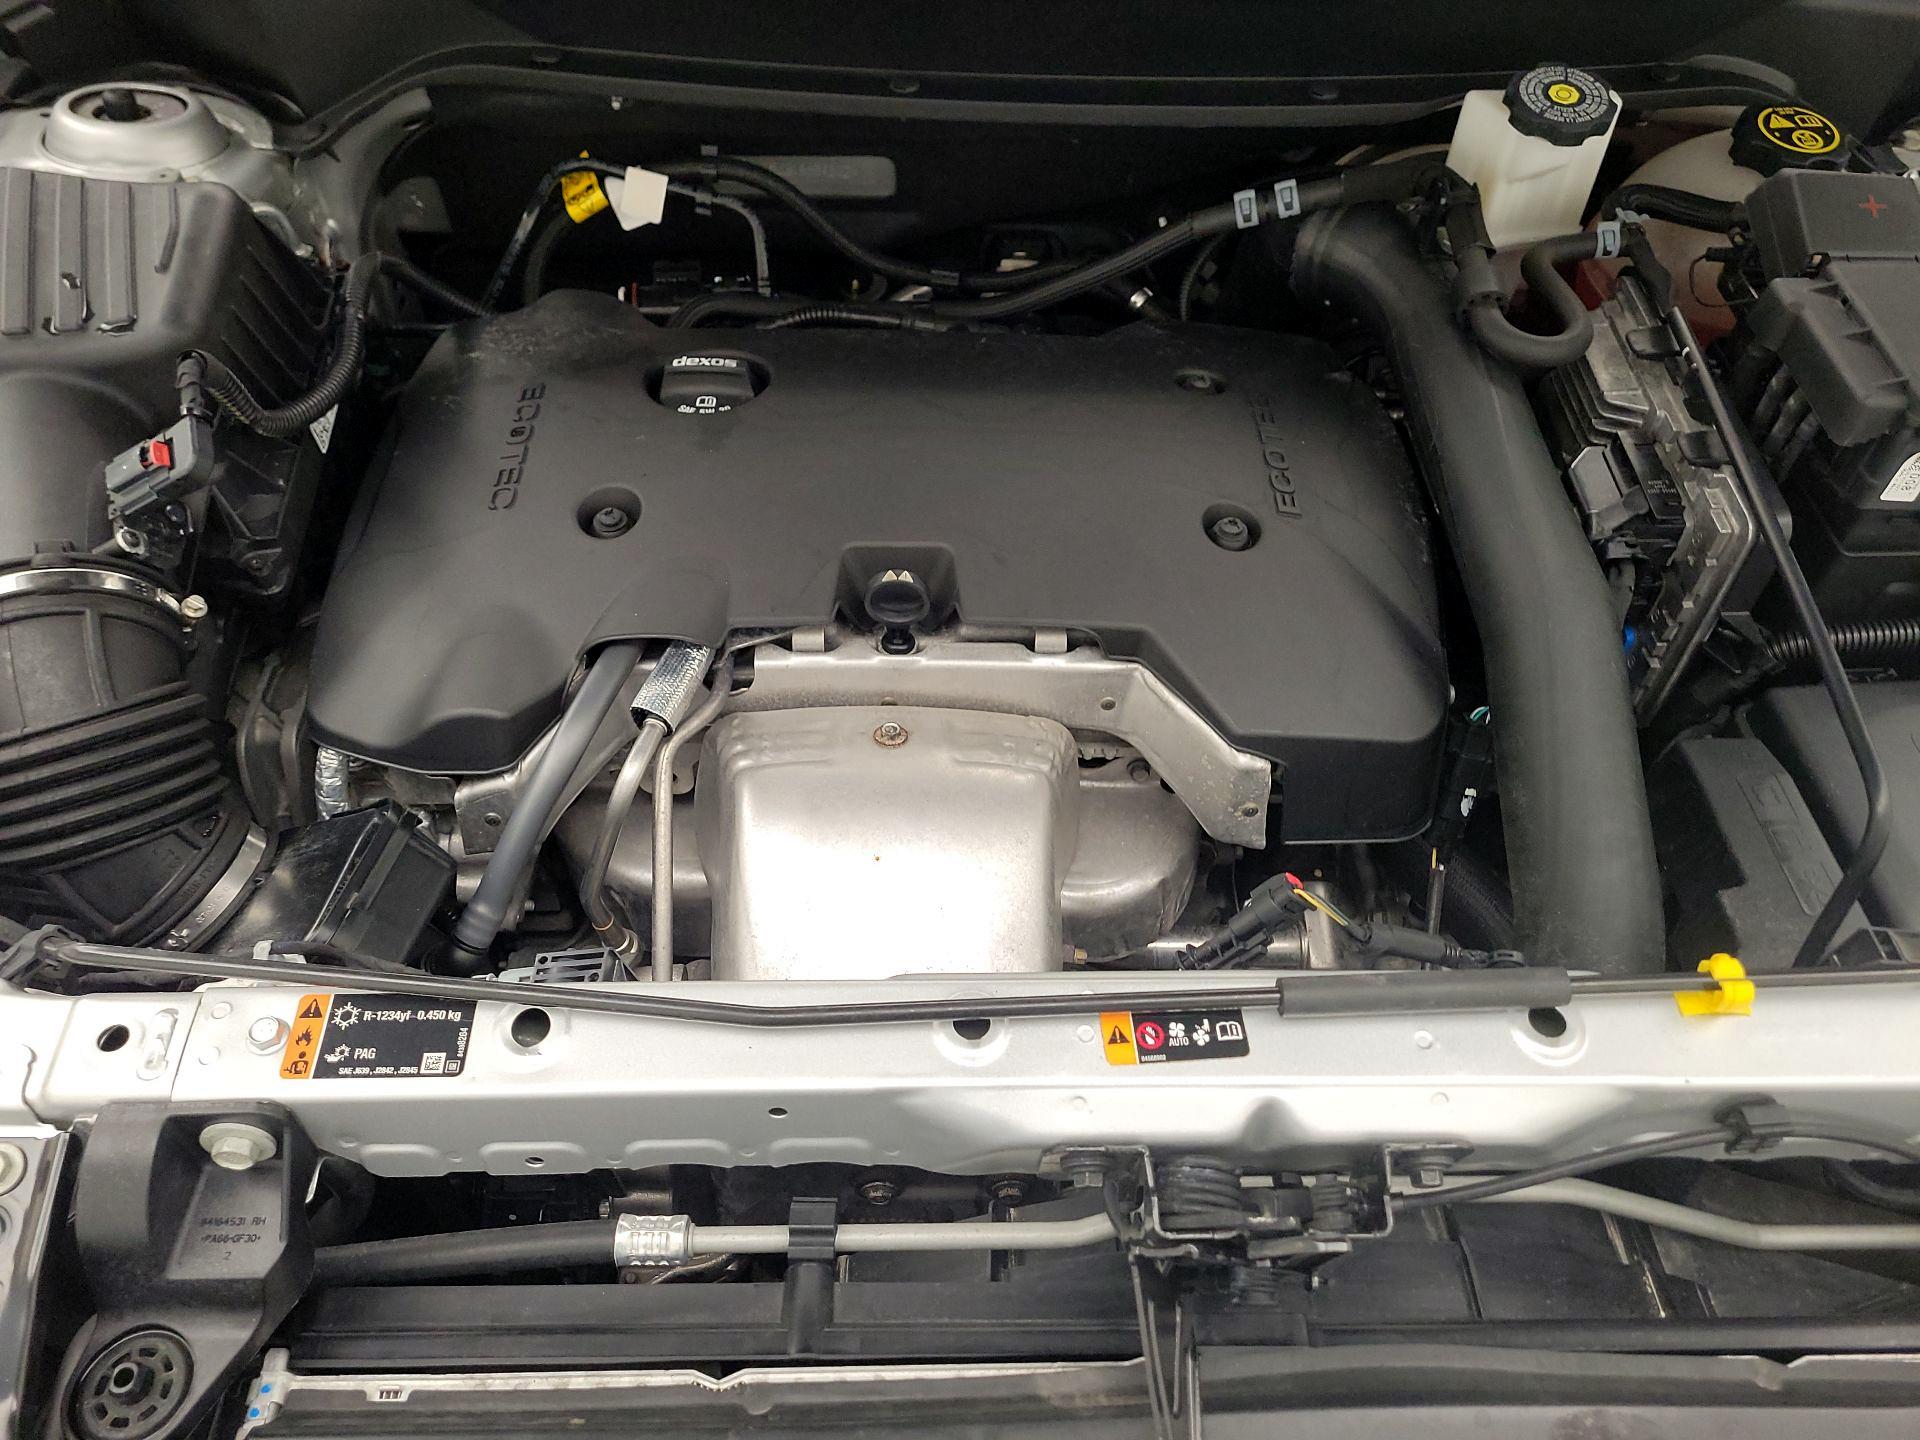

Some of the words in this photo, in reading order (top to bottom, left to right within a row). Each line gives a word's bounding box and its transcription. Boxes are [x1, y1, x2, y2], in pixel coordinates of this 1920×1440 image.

[672, 355, 737, 368] dexos
[488, 382, 546, 511] ECOTEC
[363, 1010, 411, 1022] R-1234yf
[417, 1010, 446, 1021] 0.450
[447, 1010, 462, 1022] kg
[1168, 1036, 1190, 1047] AUTO
[353, 1048, 377, 1060] PAG
[338, 1066, 353, 1075] SAE
[251, 1216, 267, 1226] RH
